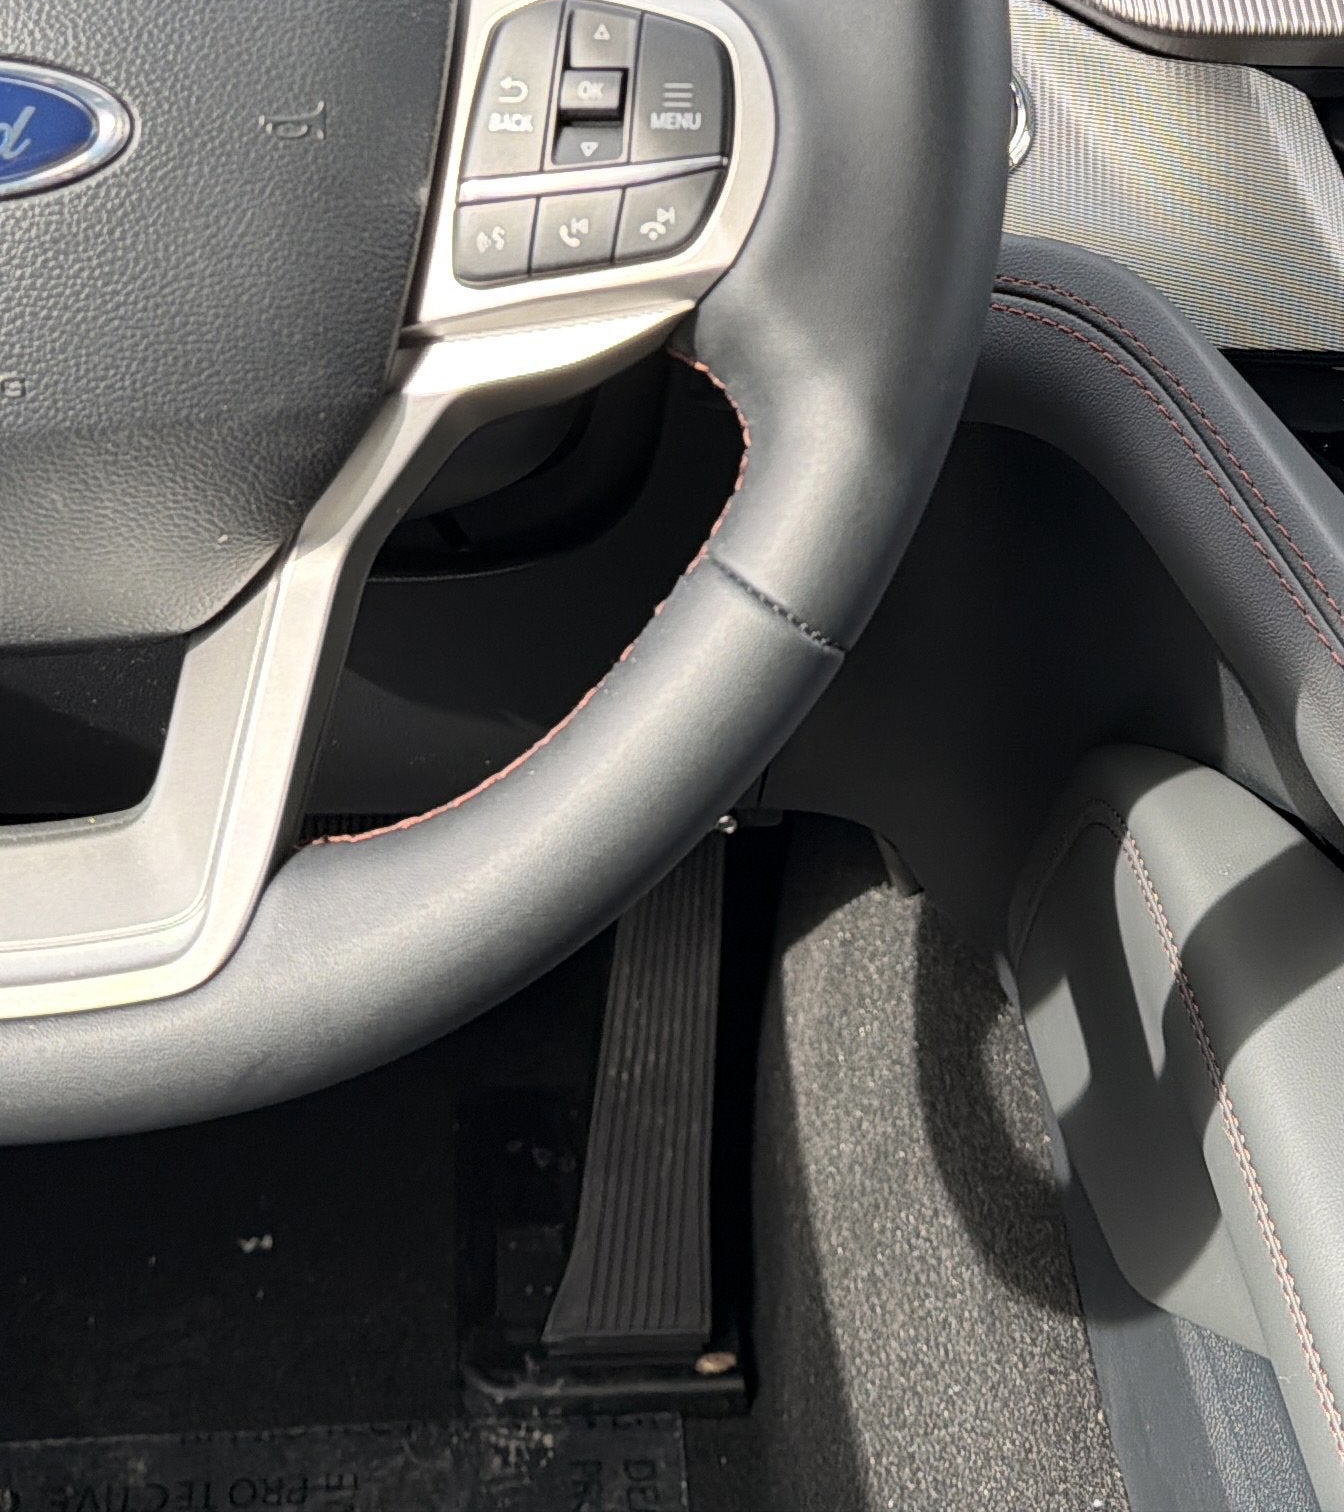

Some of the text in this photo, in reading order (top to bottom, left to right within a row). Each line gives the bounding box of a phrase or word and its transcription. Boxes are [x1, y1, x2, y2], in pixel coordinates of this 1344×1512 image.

[576, 80, 604, 100] OK
[488, 112, 534, 133] BACK
[650, 111, 702, 131] MENU
